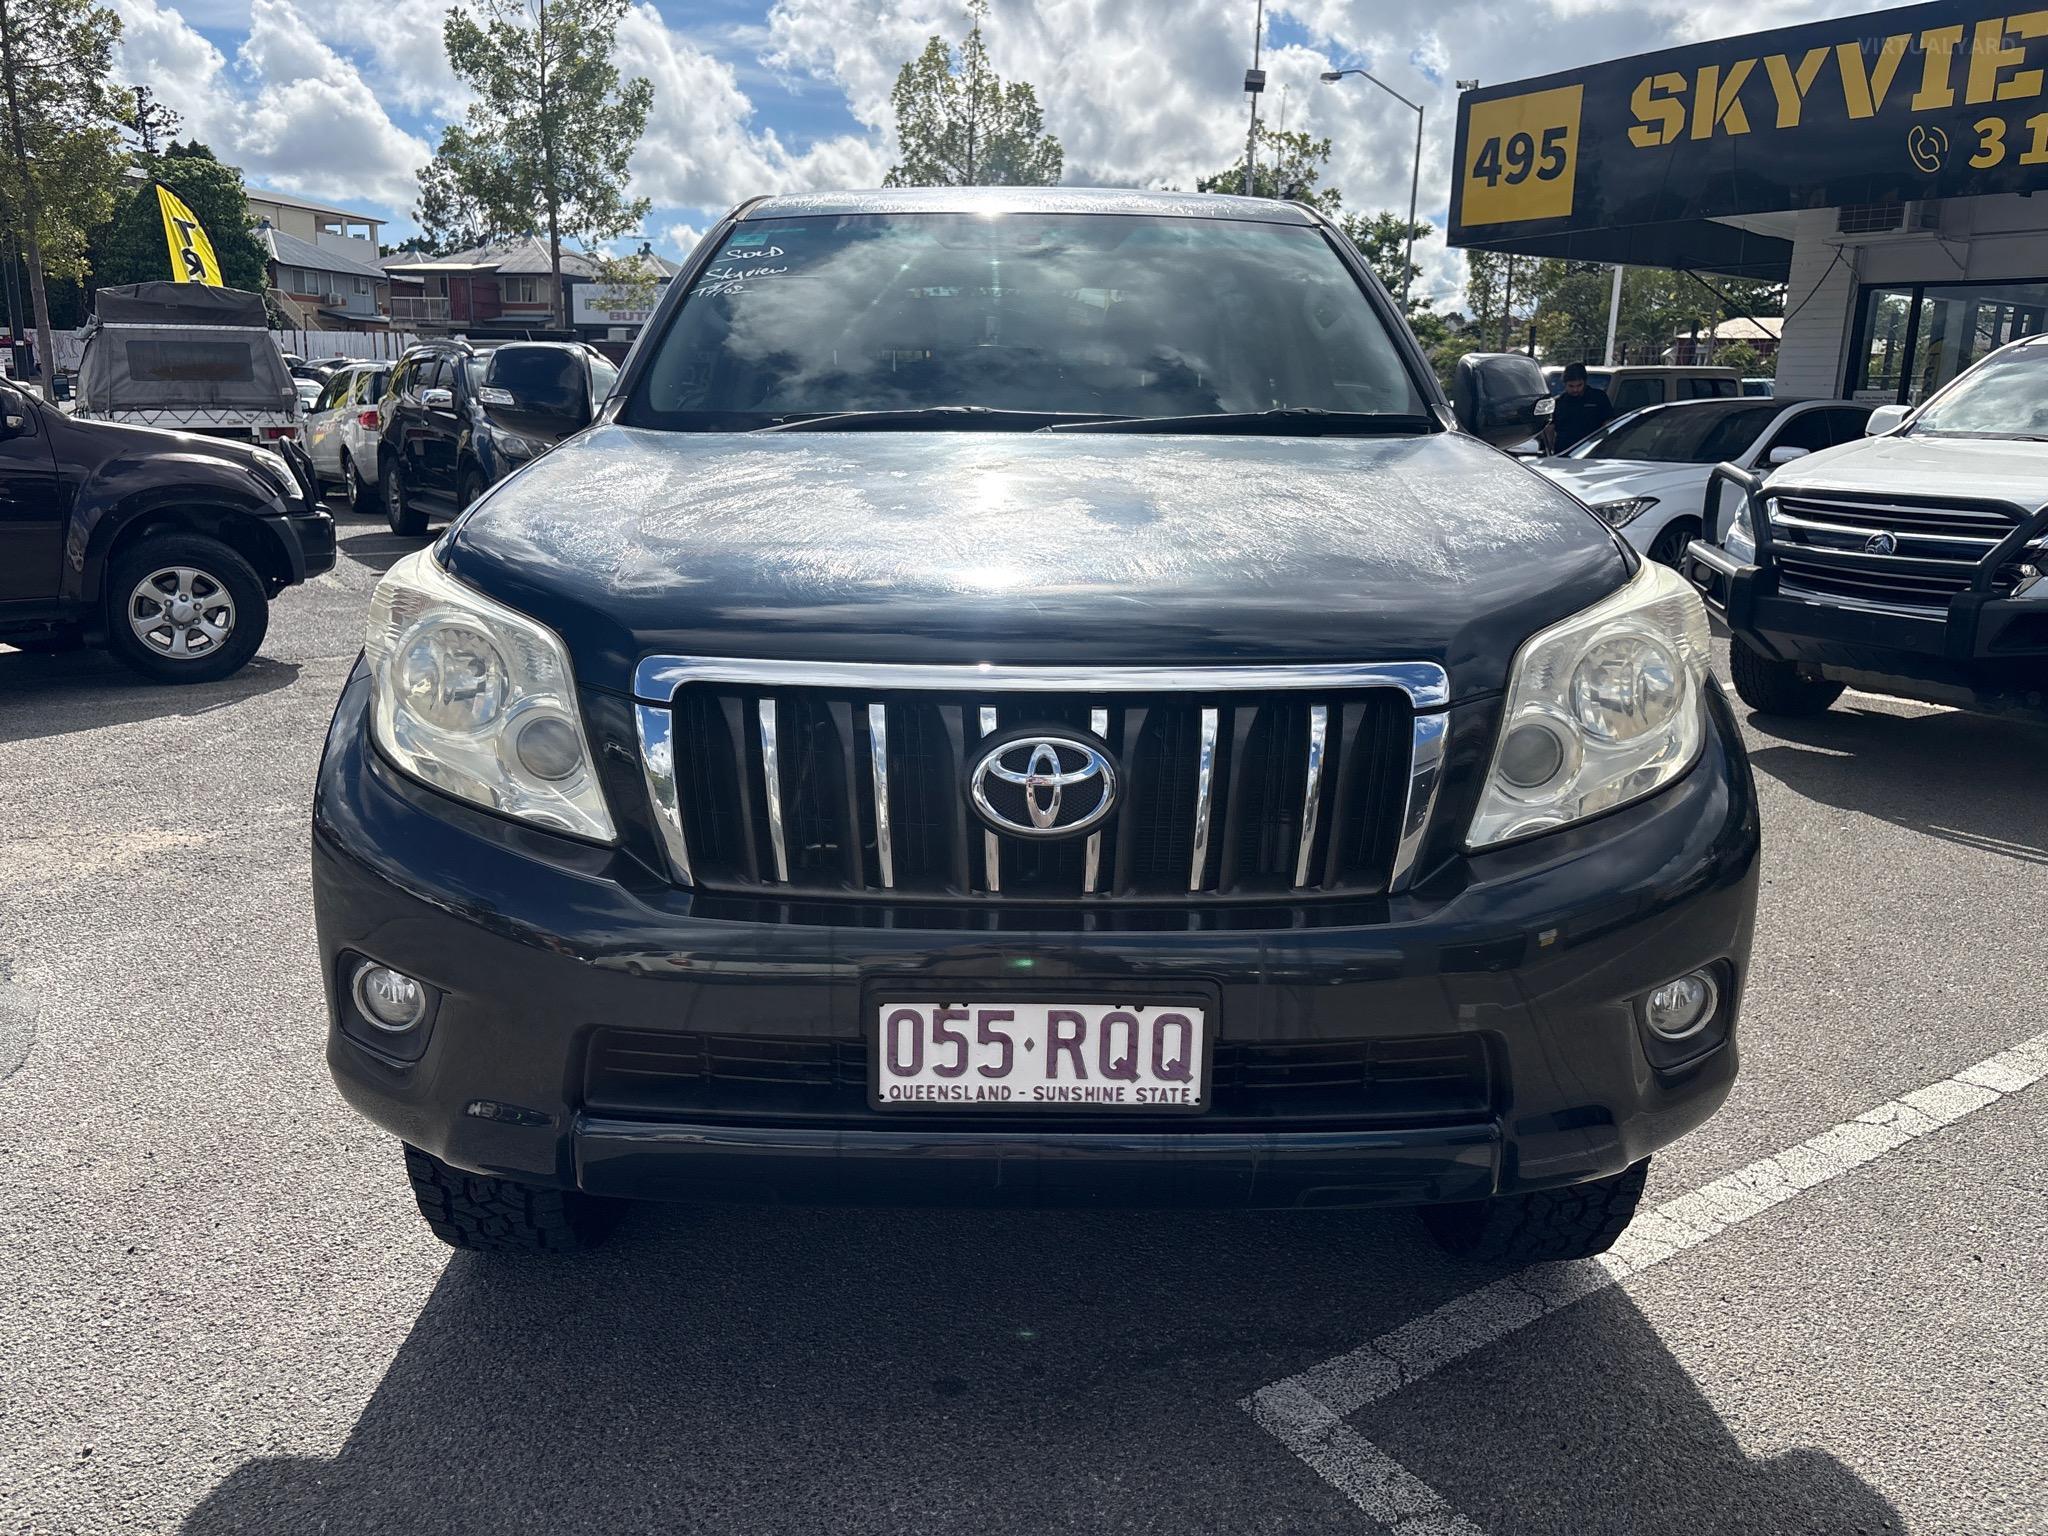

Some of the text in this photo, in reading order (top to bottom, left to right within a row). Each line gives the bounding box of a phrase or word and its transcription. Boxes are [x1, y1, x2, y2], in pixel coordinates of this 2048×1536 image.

[1627, 10, 2048, 150] SKYVIE
[1472, 125, 1568, 188] 495
[889, 1084, 1012, 1101] QUEENSLAND
[1033, 1085, 1125, 1102] SUNSHINE
[1135, 1086, 1191, 1104] STATE
